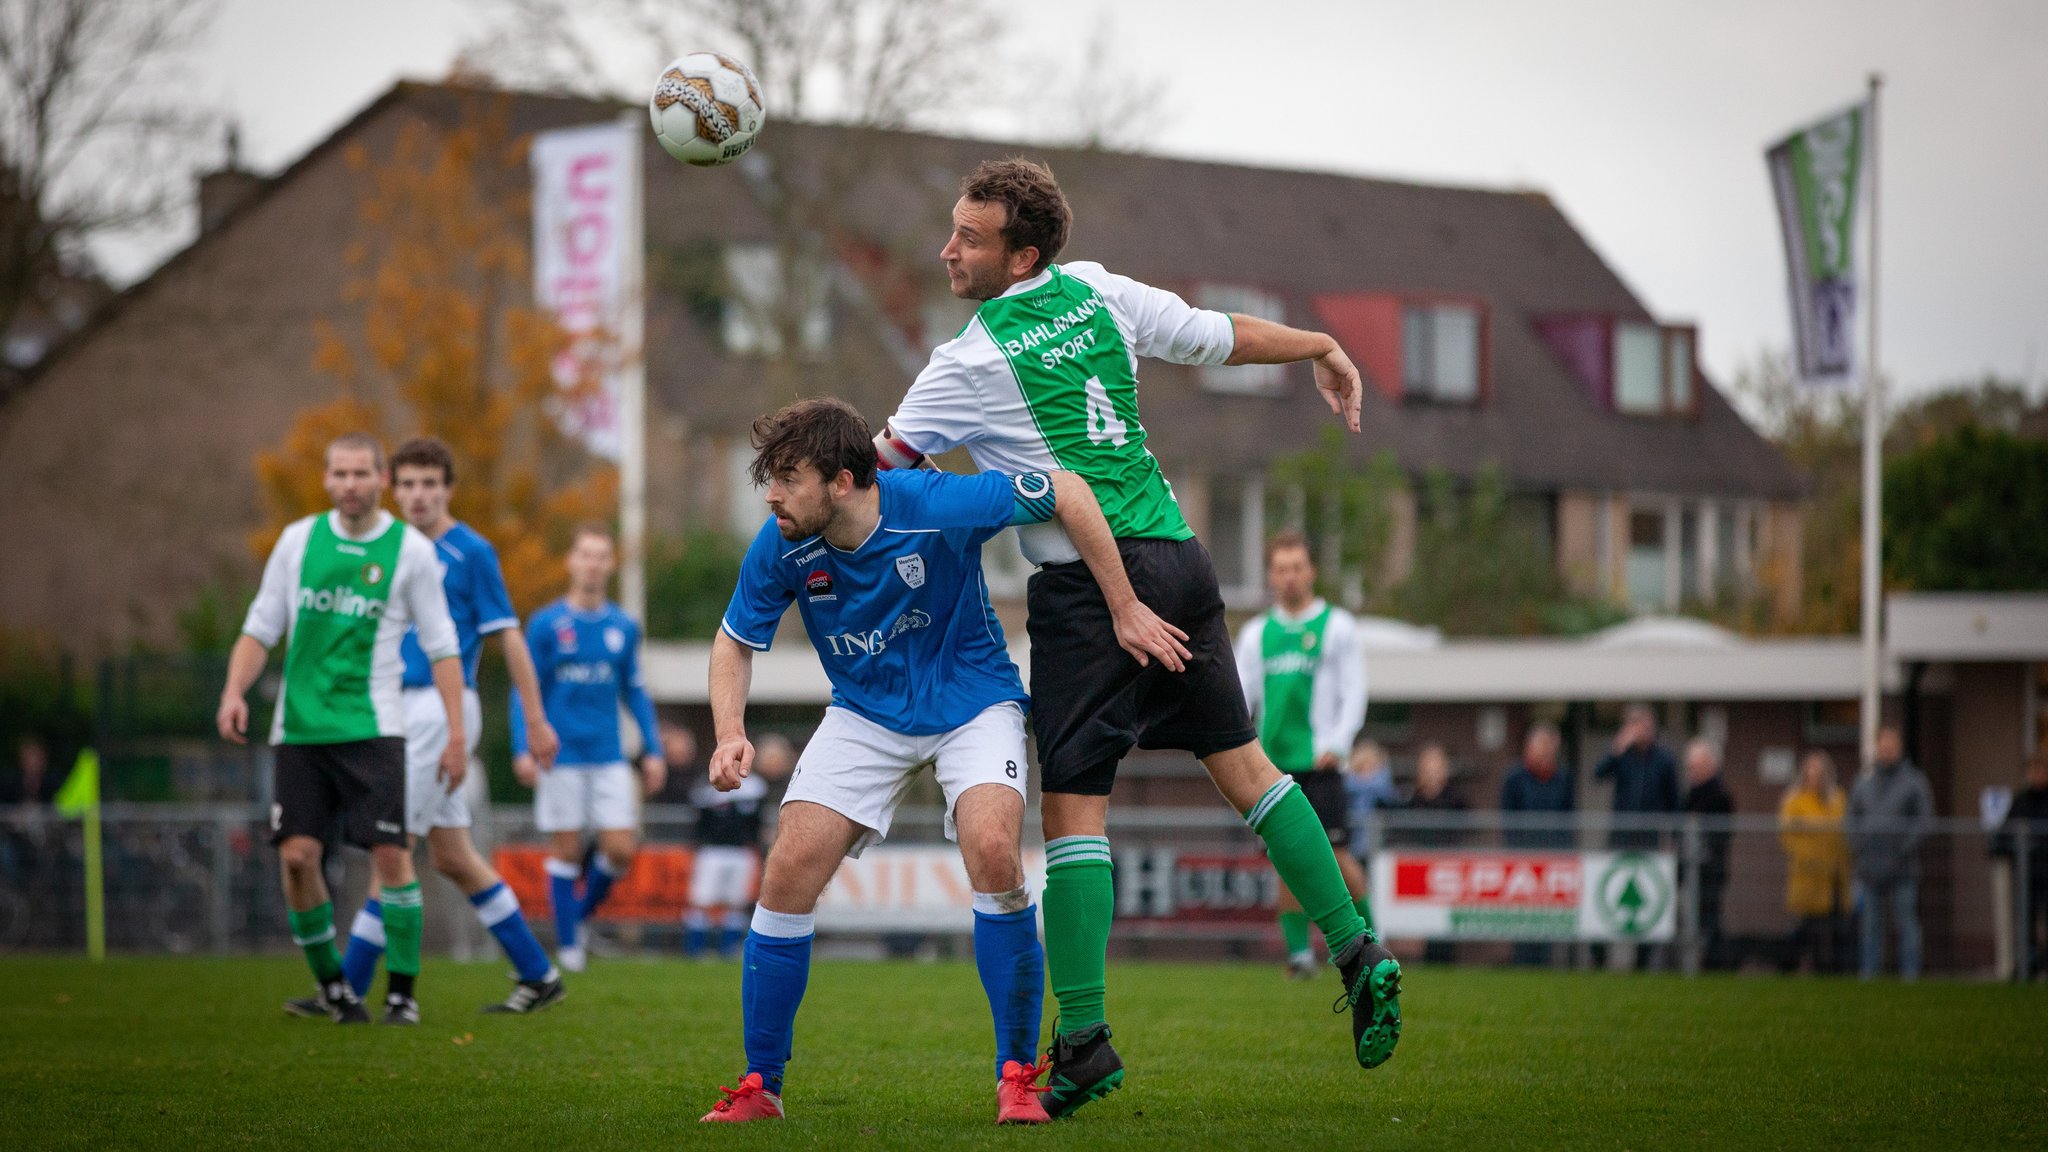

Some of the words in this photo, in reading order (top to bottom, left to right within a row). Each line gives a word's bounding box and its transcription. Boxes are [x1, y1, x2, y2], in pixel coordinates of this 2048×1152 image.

[1004, 292, 1104, 357] BAHLMANN
[1041, 328, 1096, 370] SPORT
[1084, 375, 1129, 450] 4
[1014, 472, 1049, 499] C
[795, 546, 827, 567] hummel
[807, 576, 828, 585] SPORT
[811, 581, 828, 589] 2000
[825, 629, 887, 656] ING
[1005, 760, 1018, 779] 8
[1431, 864, 1582, 899] SPAR
